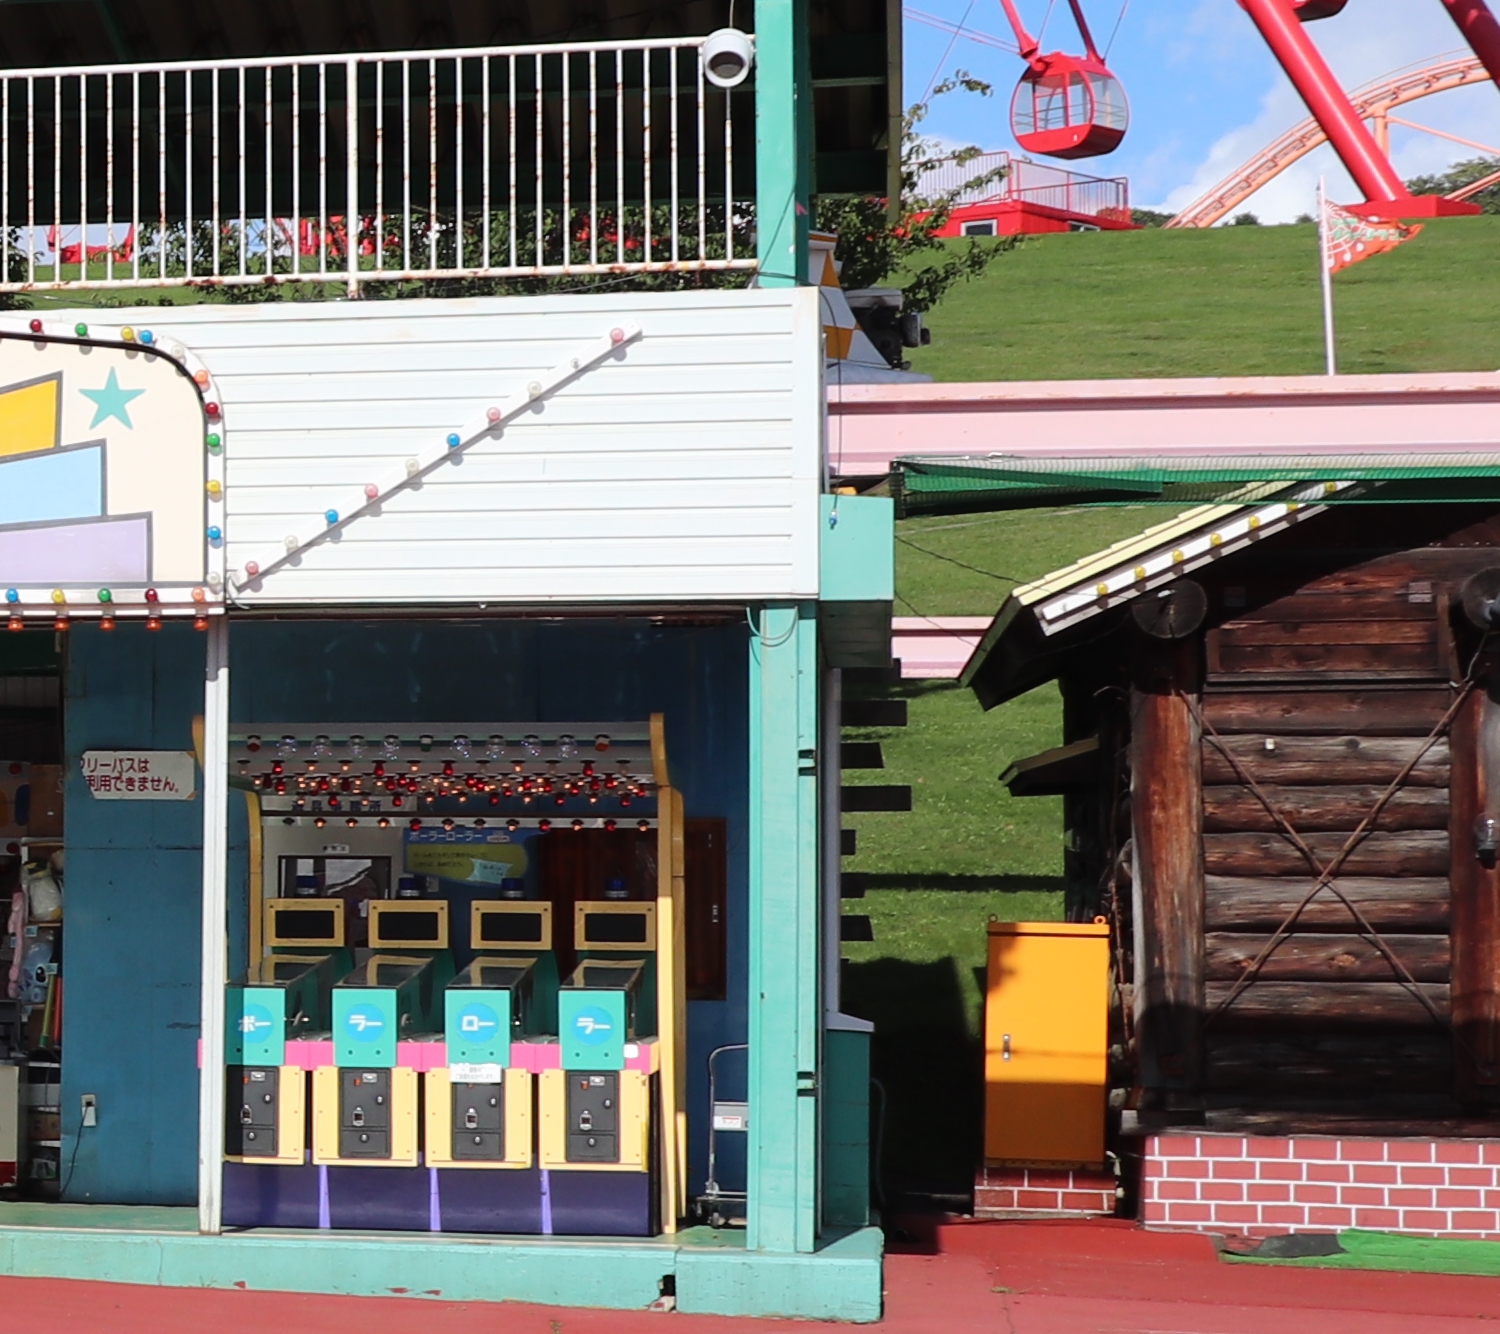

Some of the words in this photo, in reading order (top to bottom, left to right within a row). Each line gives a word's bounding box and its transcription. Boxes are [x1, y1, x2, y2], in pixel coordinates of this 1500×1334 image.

[349, 1014, 383, 1031] ラー
[461, 1015, 495, 1031] ロー
[576, 1017, 611, 1034] ラー
